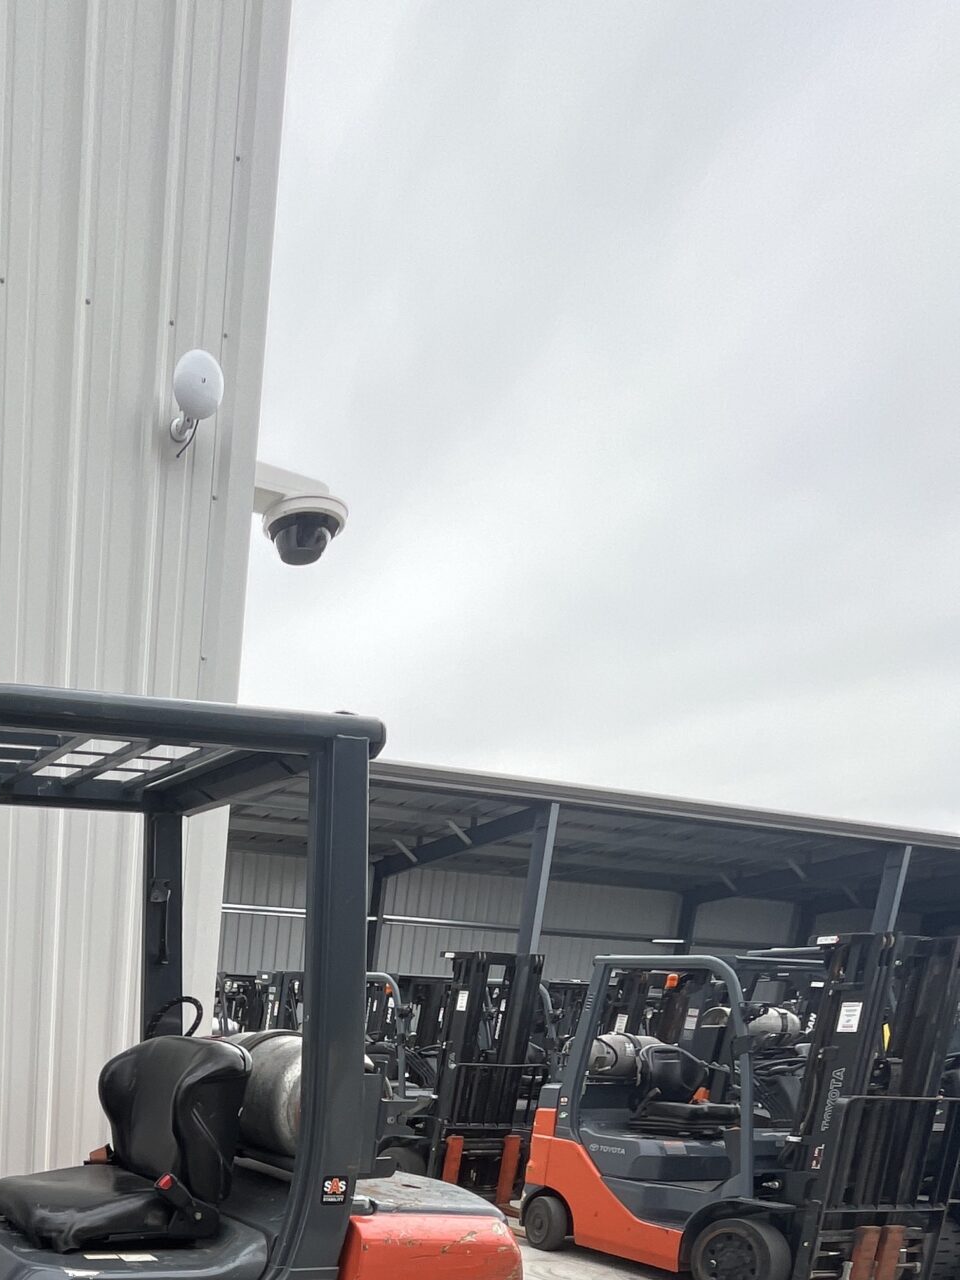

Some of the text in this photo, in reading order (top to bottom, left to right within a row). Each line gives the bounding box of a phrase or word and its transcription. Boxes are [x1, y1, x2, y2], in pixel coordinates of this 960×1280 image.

[821, 1067, 846, 1131] TOYOTA
[600, 1145, 625, 1155] TOYOTA
[323, 1178, 346, 1194] SAS
